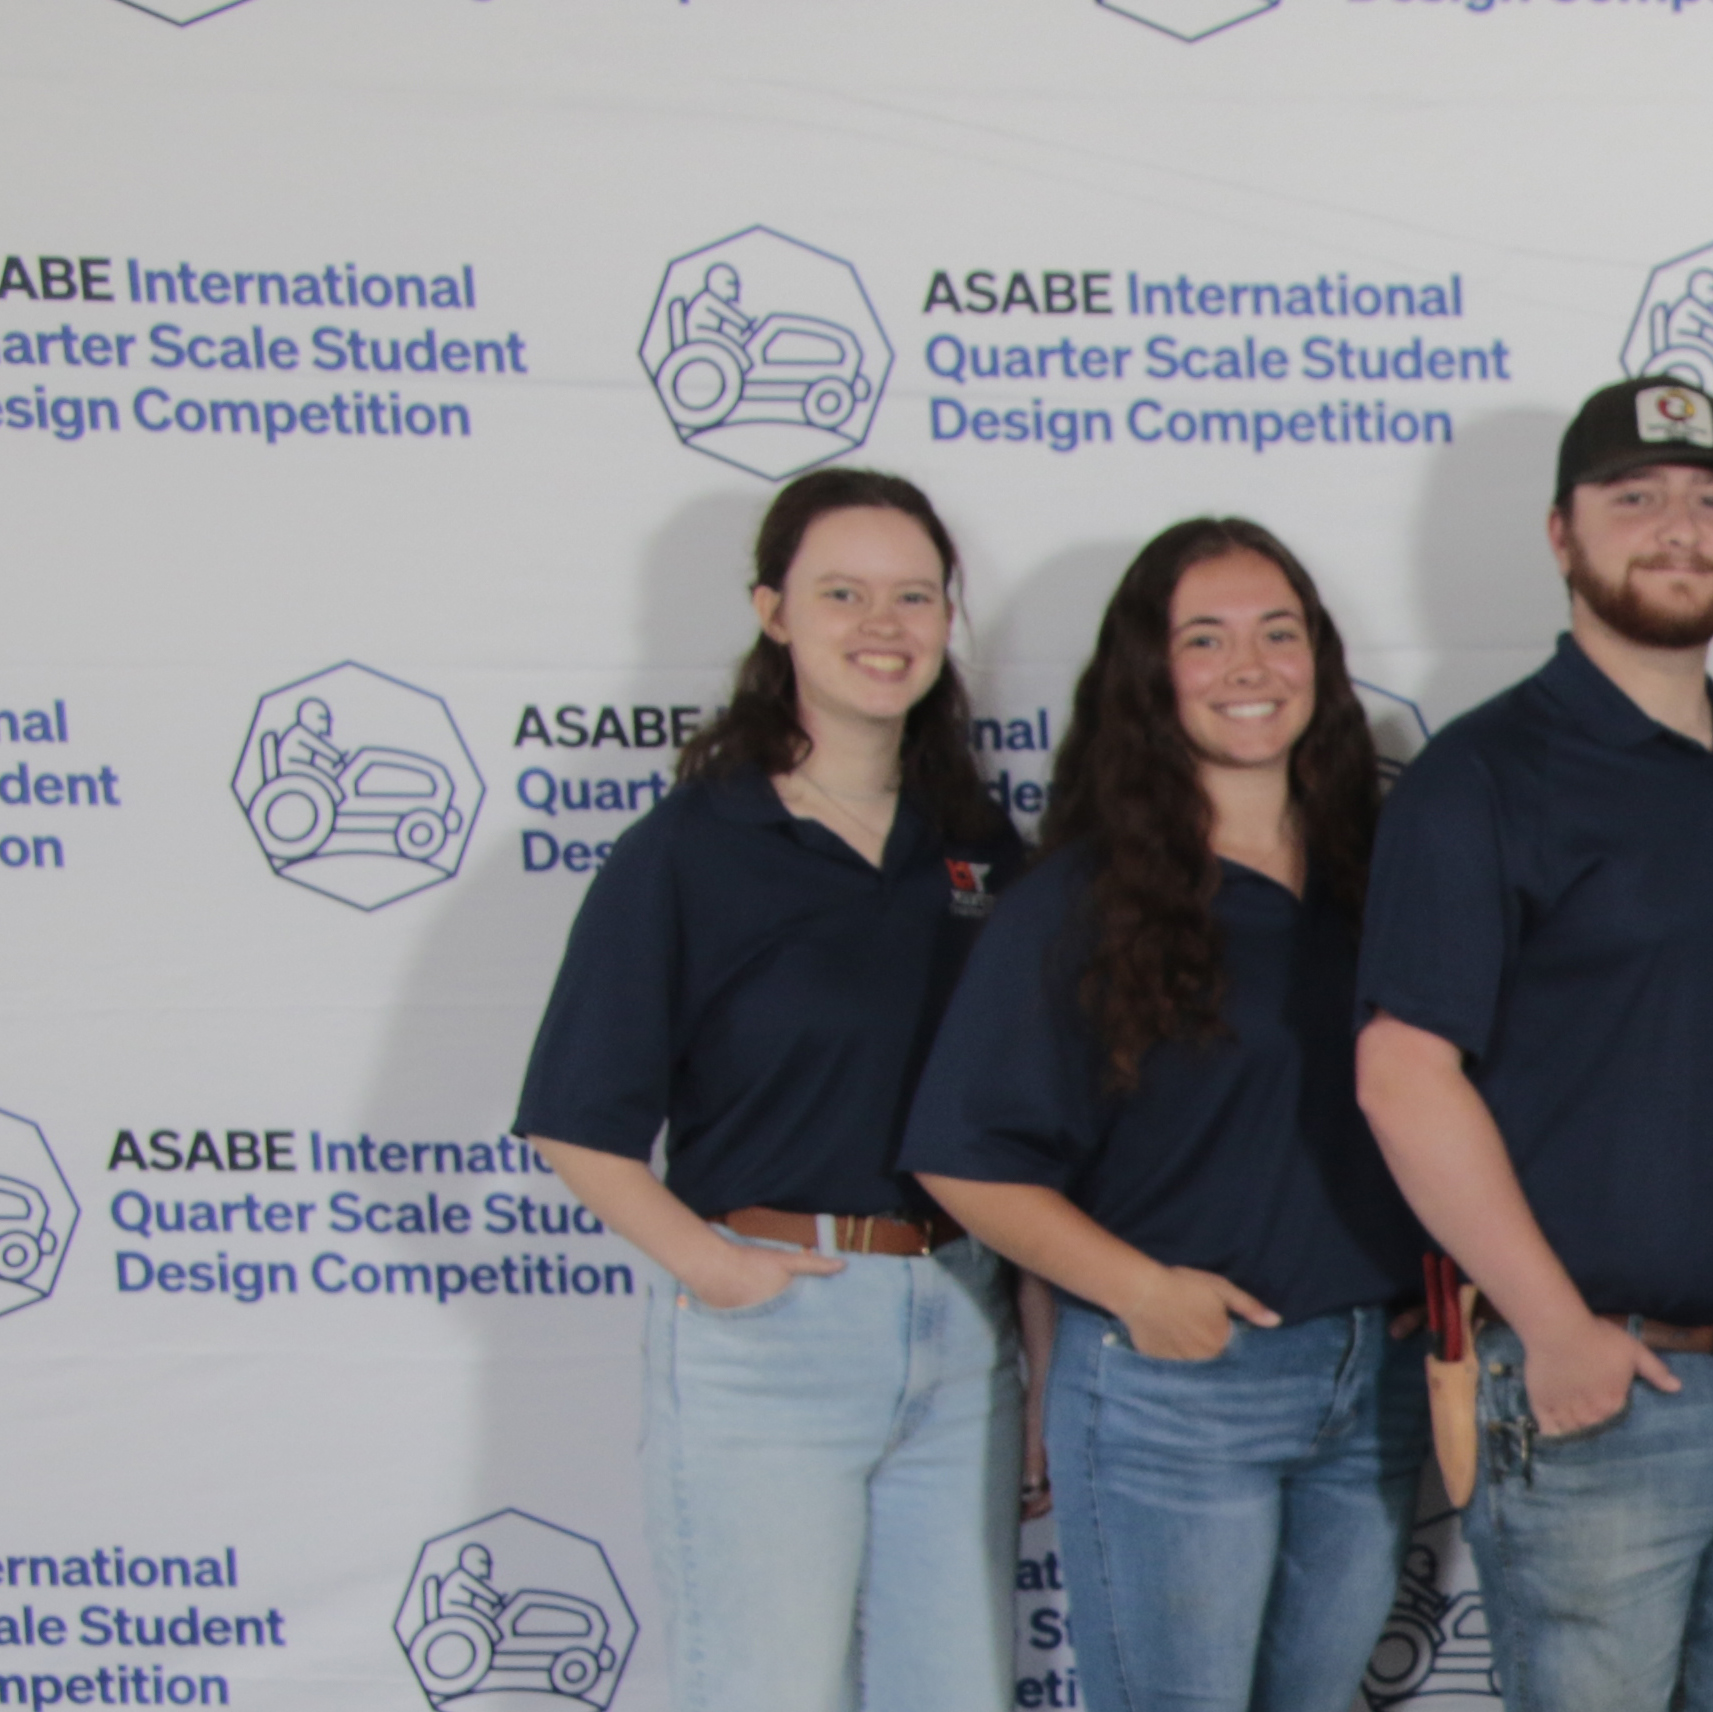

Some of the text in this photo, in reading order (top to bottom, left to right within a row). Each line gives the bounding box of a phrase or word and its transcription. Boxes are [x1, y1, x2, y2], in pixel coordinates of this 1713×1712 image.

[0, 255, 474, 308] ABE International
[923, 270, 1462, 316] ASABE International
[0, 323, 526, 373] arter Scale Student
[925, 333, 1510, 383] Quarter Scale Student
[0, 385, 470, 443] sign Competition
[930, 396, 1453, 452] Design Competition
[513, 704, 702, 748] ASABE
[0, 762, 119, 805] dent
[515, 768, 665, 815] Quart
[108, 1130, 295, 1171] ASABE
[110, 1190, 606, 1238] Quarter Scale Stud
[116, 1251, 635, 1305] Design Competition
[0, 1547, 236, 1587] rnational
[0, 1605, 284, 1646] ale Student
